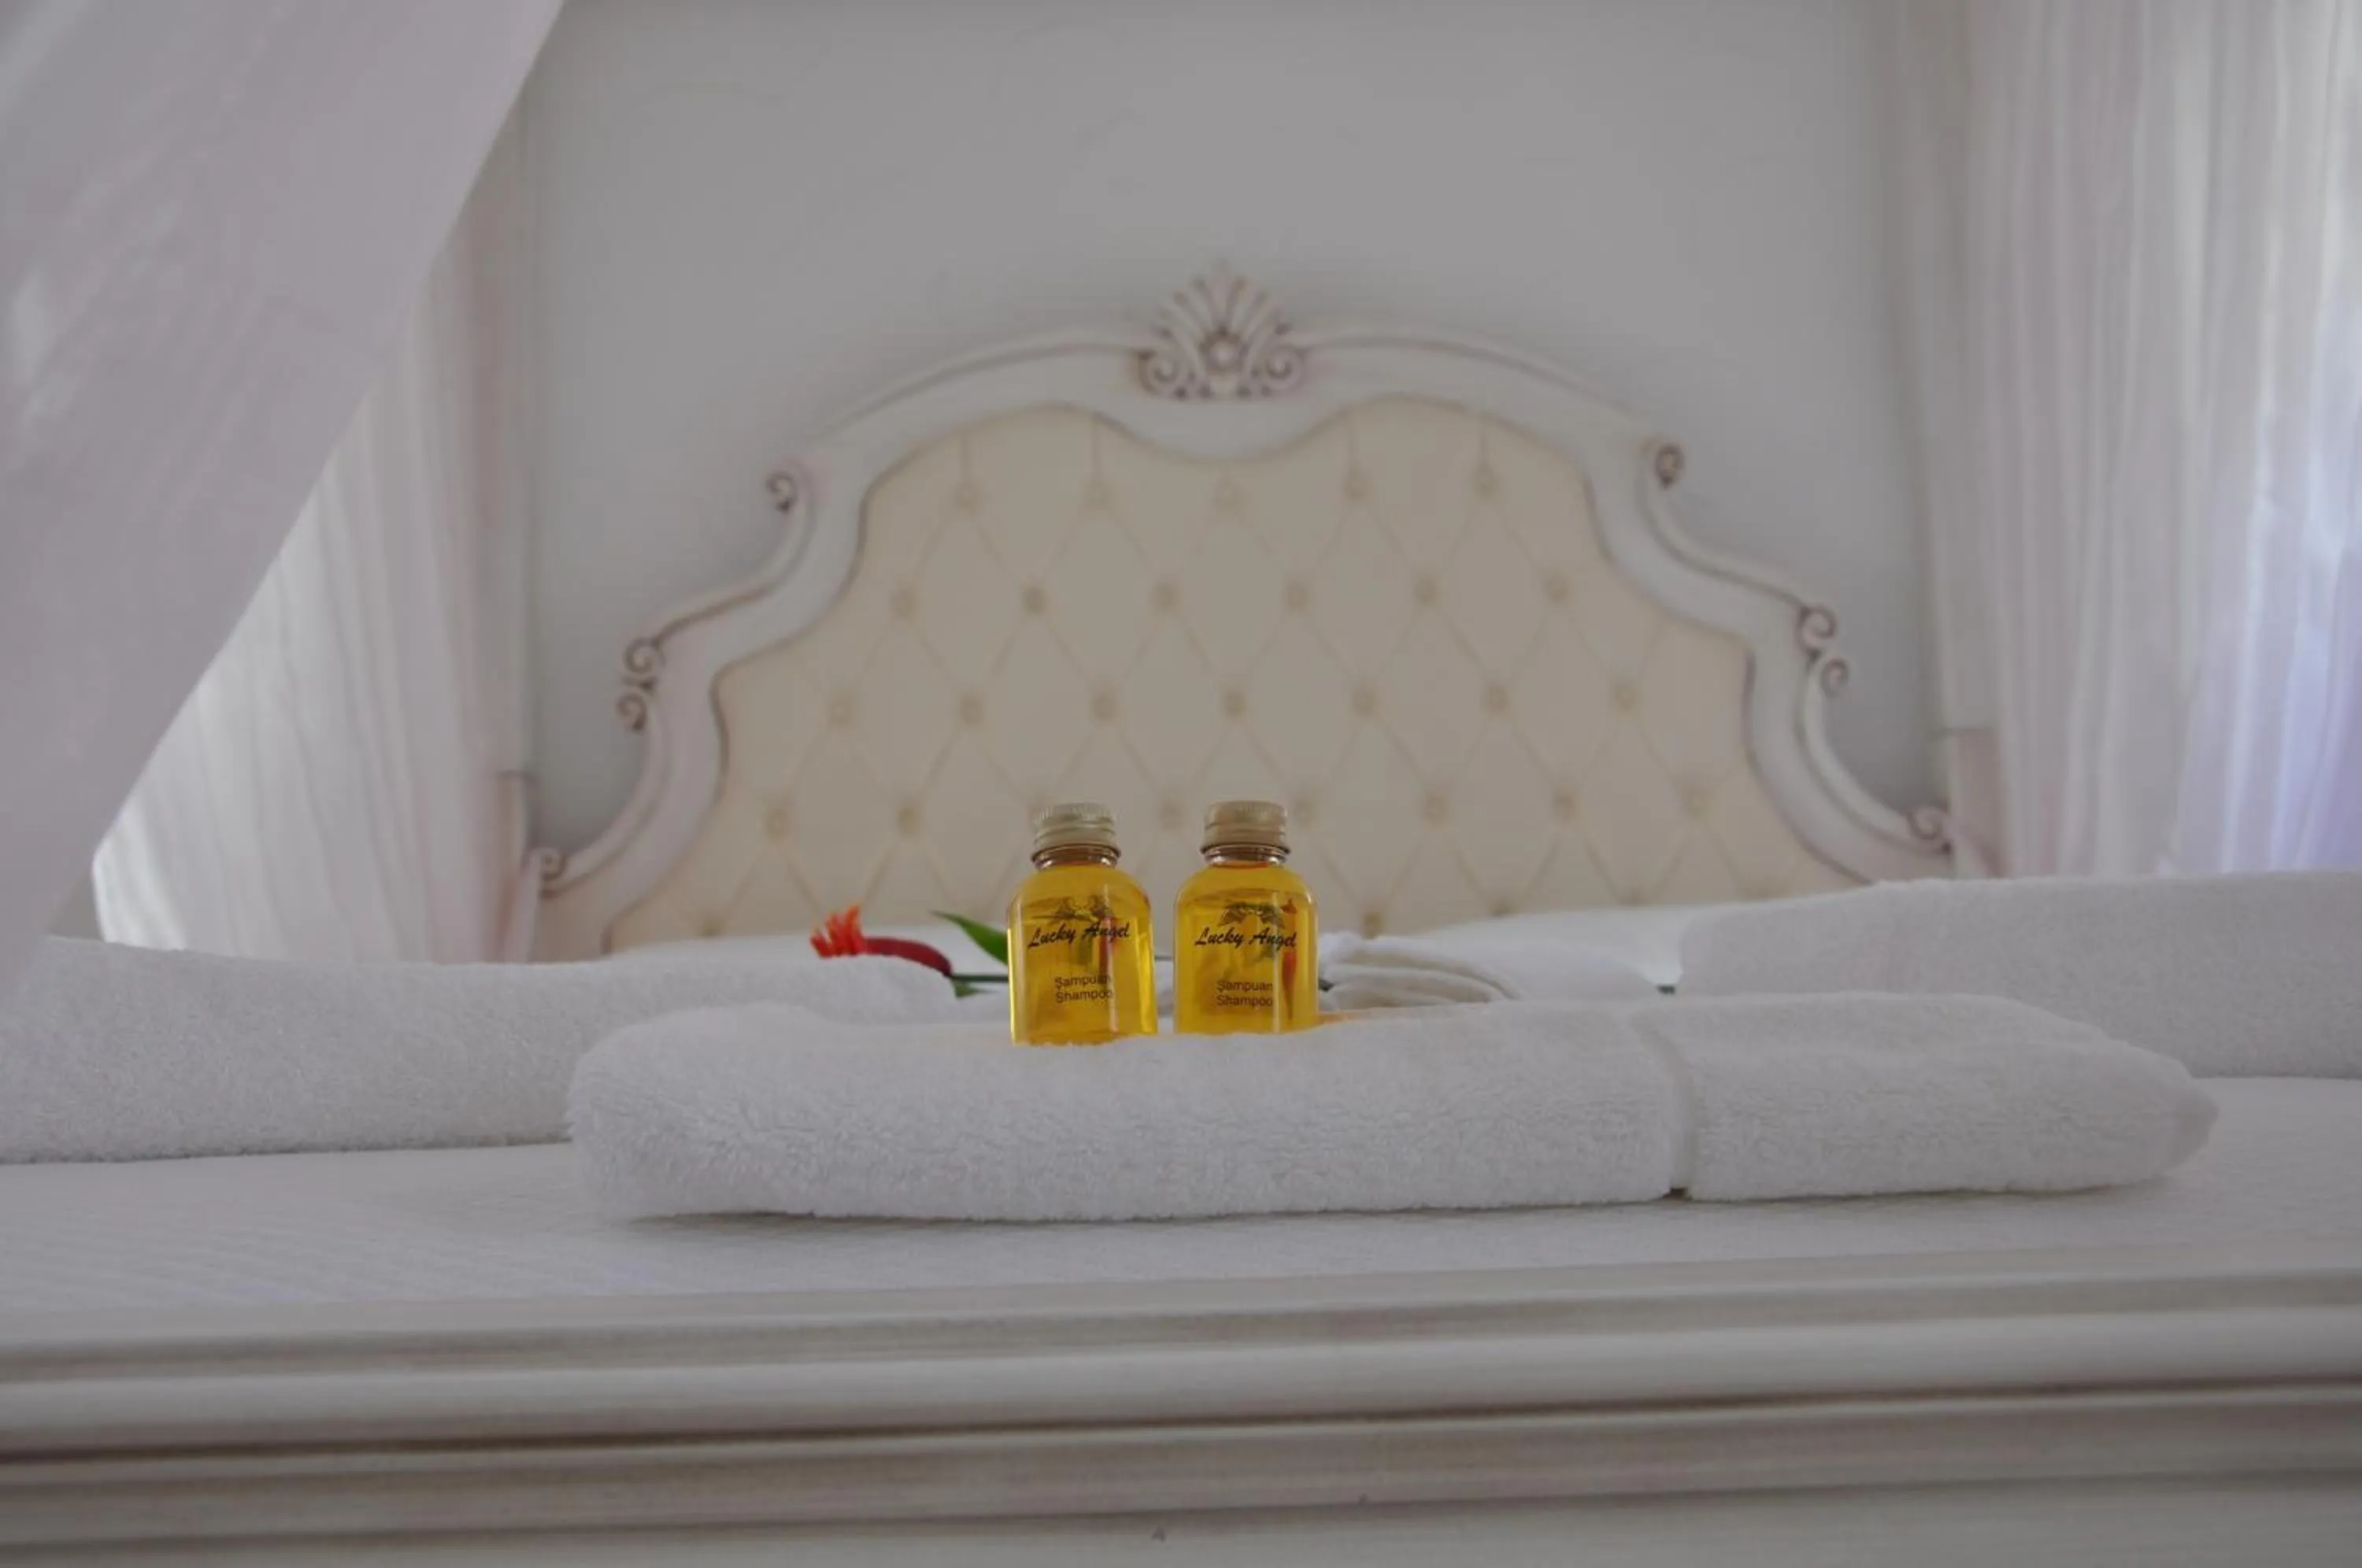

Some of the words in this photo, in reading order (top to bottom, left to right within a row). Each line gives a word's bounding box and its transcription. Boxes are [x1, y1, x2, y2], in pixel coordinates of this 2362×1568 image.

[1027, 923, 1076, 949] Lucky
[1194, 926, 1245, 949] Lucky
[1056, 989, 1113, 1004] Shampoo
[1216, 994, 1274, 1008] Shampoo
